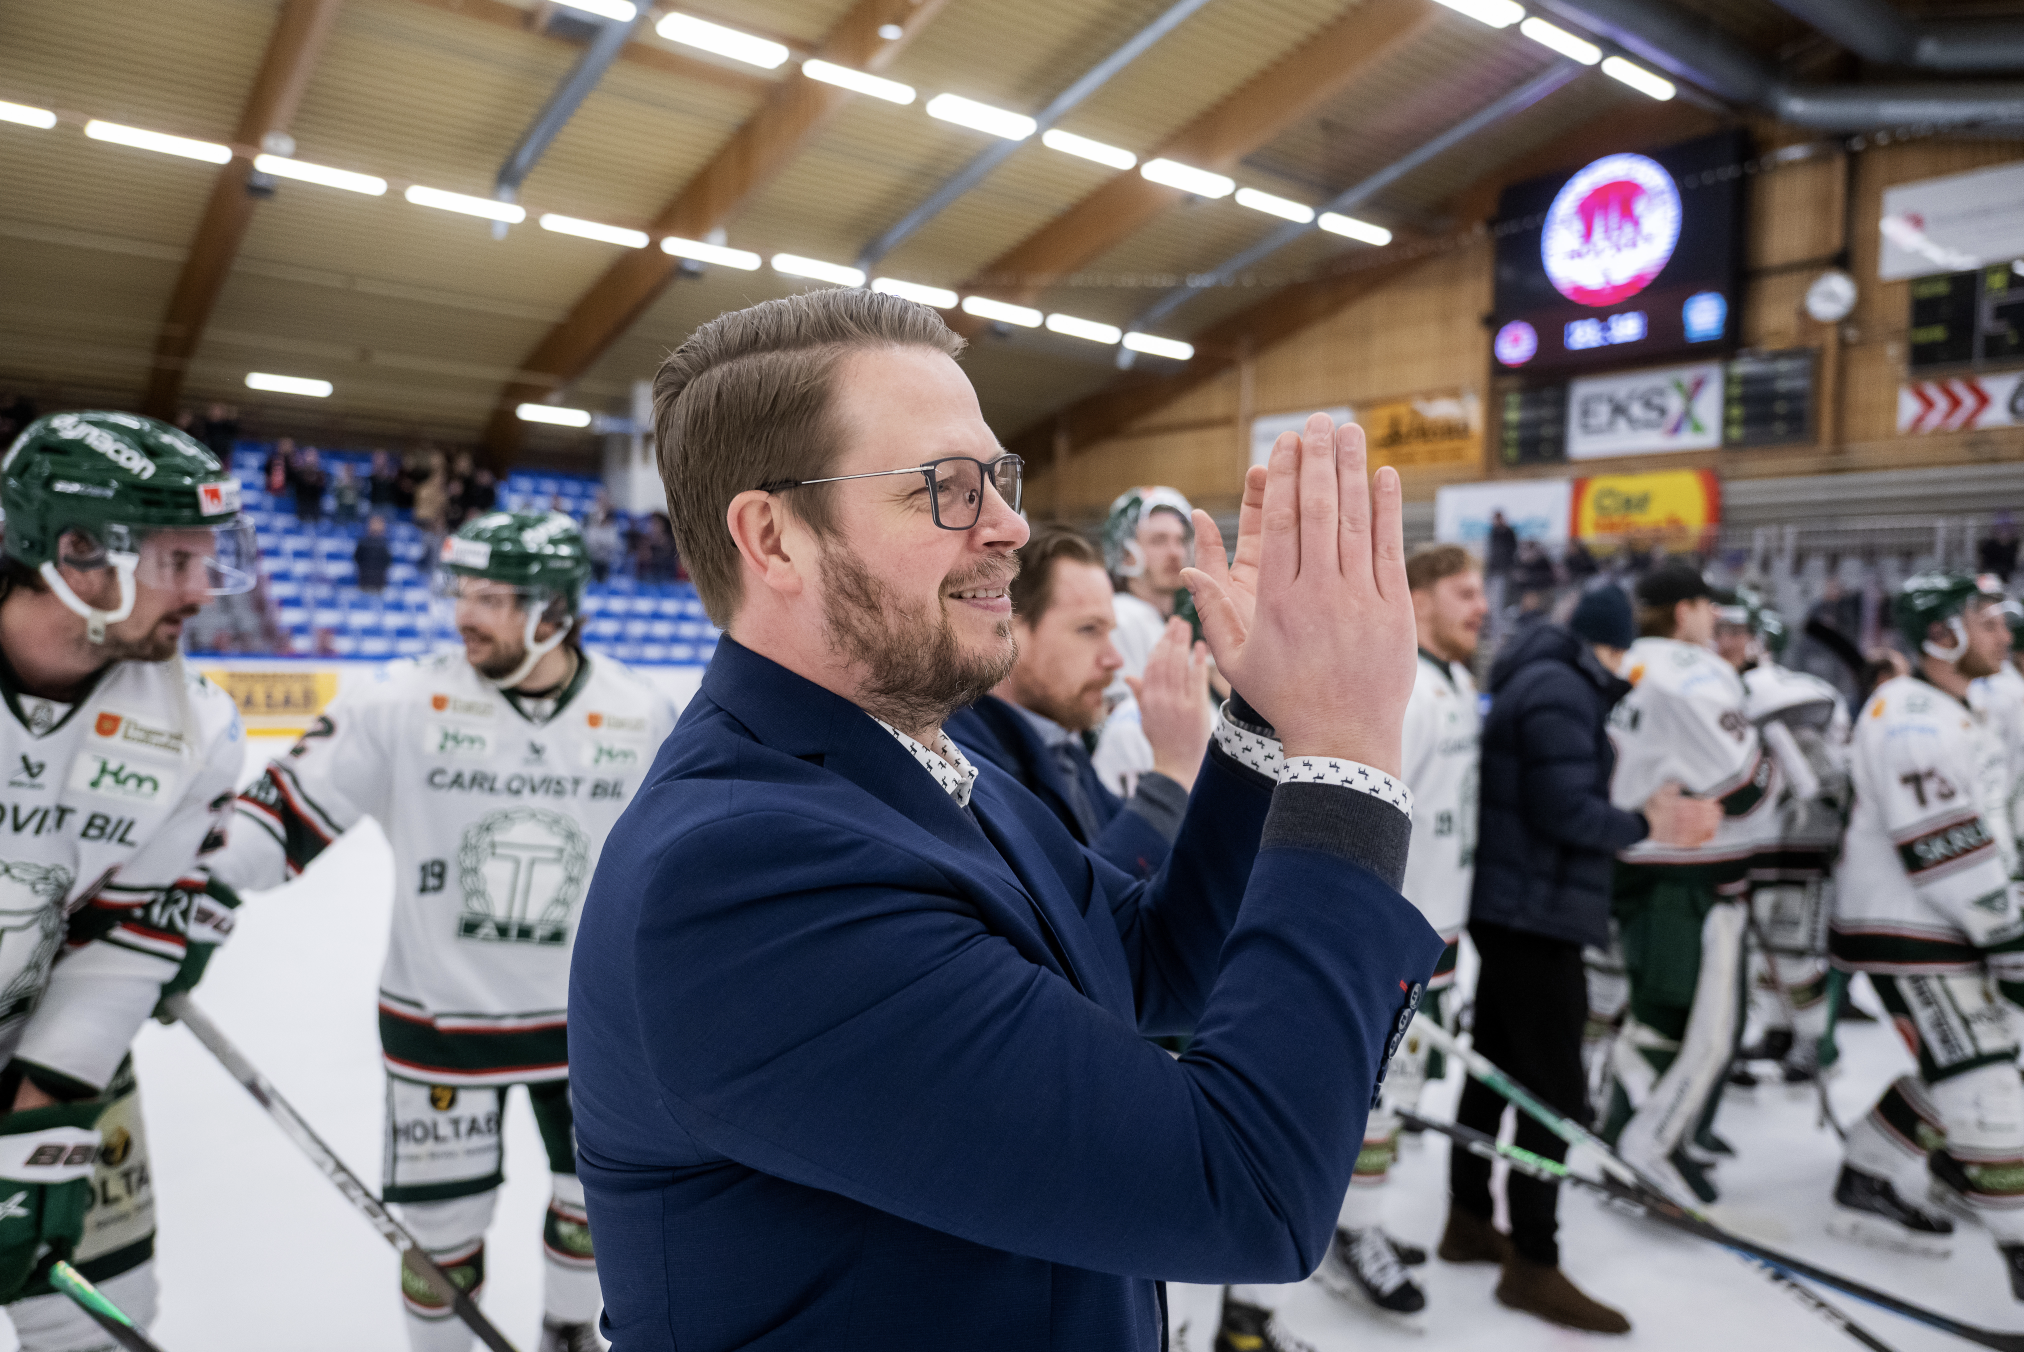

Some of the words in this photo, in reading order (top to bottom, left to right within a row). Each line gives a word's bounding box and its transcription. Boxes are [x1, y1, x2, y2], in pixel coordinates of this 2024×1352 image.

[427, 766, 583, 798] CARLQVIST
[80, 811, 137, 847] BIL
[418, 859, 447, 895] 19
